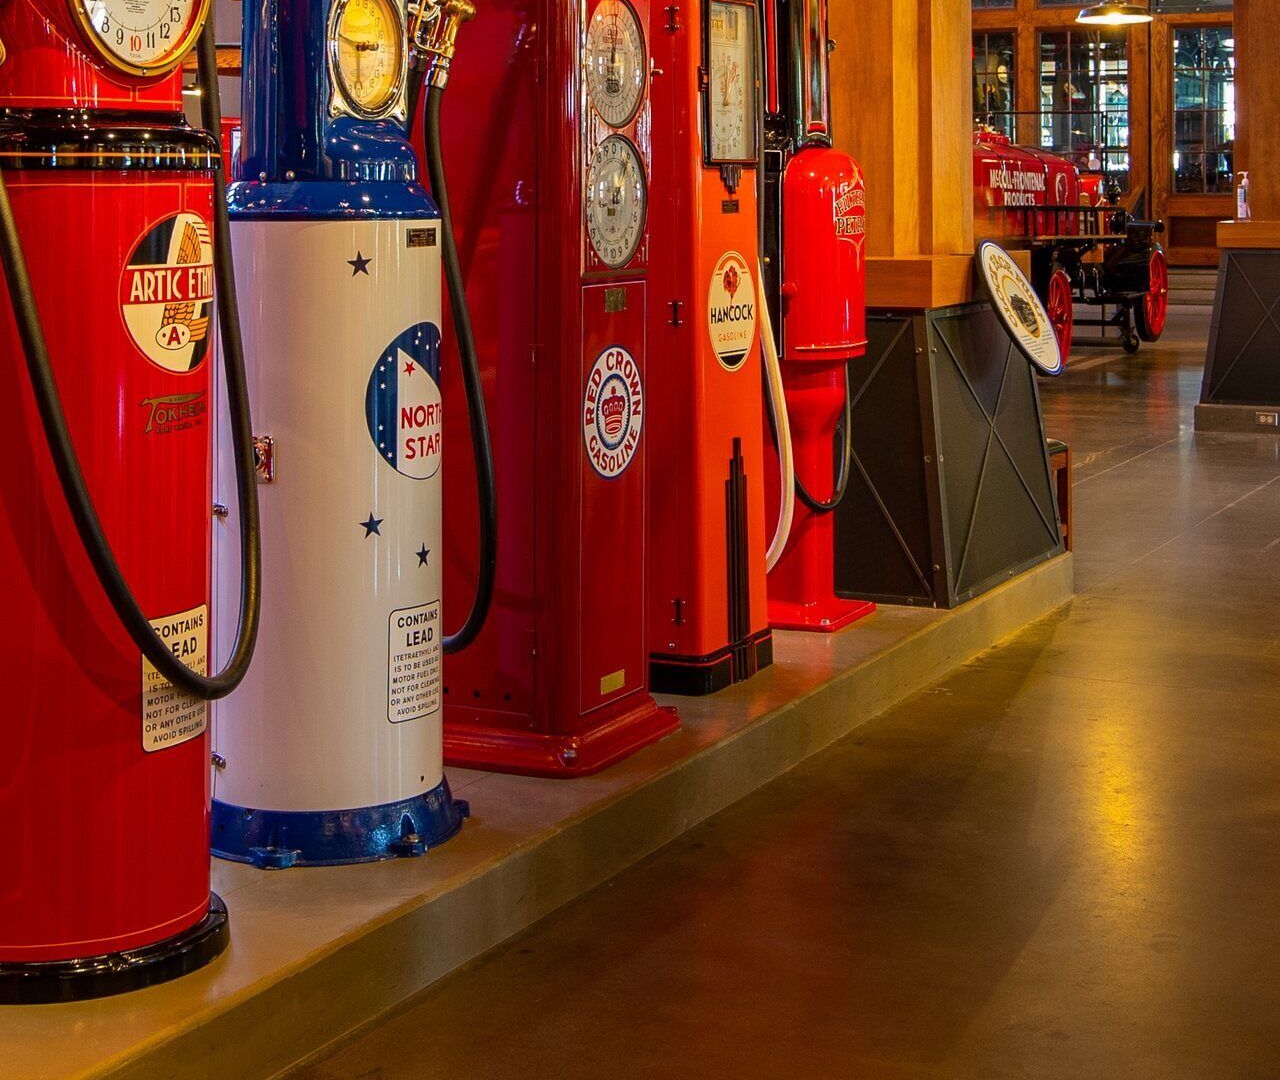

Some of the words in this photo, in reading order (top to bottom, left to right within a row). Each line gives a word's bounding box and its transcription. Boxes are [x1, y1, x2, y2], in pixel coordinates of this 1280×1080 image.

[130, 35, 142, 52] 10
[1004, 191, 1036, 206] PRODUCTS
[129, 268, 182, 302] ARTIC
[710, 303, 754, 325] HANCOCK
[166, 325, 181, 346] A
[718, 330, 748, 343] GASOLINE
[585, 367, 603, 426] RED
[605, 350, 642, 416] CROWN
[589, 425, 638, 473] GASOLINE
[153, 613, 204, 639] CONTAINS
[397, 608, 438, 628] CONTAINS
[171, 635, 198, 658] EAD
[406, 627, 433, 647] LEAD
[404, 663, 412, 672] TO
[413, 661, 421, 669] BE
[392, 673, 415, 684] MOTOR
[417, 670, 429, 680] FUEL
[147, 692, 174, 707] MOTOR
[391, 686, 405, 695] NOT
[407, 684, 419, 693] FOR
[390, 698, 401, 706] OR
[402, 696, 414, 704] ANY
[397, 705, 416, 715] AVOID
[145, 723, 157, 733] OR
[160, 718, 174, 730] ANY
[176, 710, 196, 725] OTHER
[146, 708, 162, 720] NOT
[165, 703, 180, 717] FOR
[153, 728, 177, 744] AVOID
[178, 718, 203, 736] SPILLING
